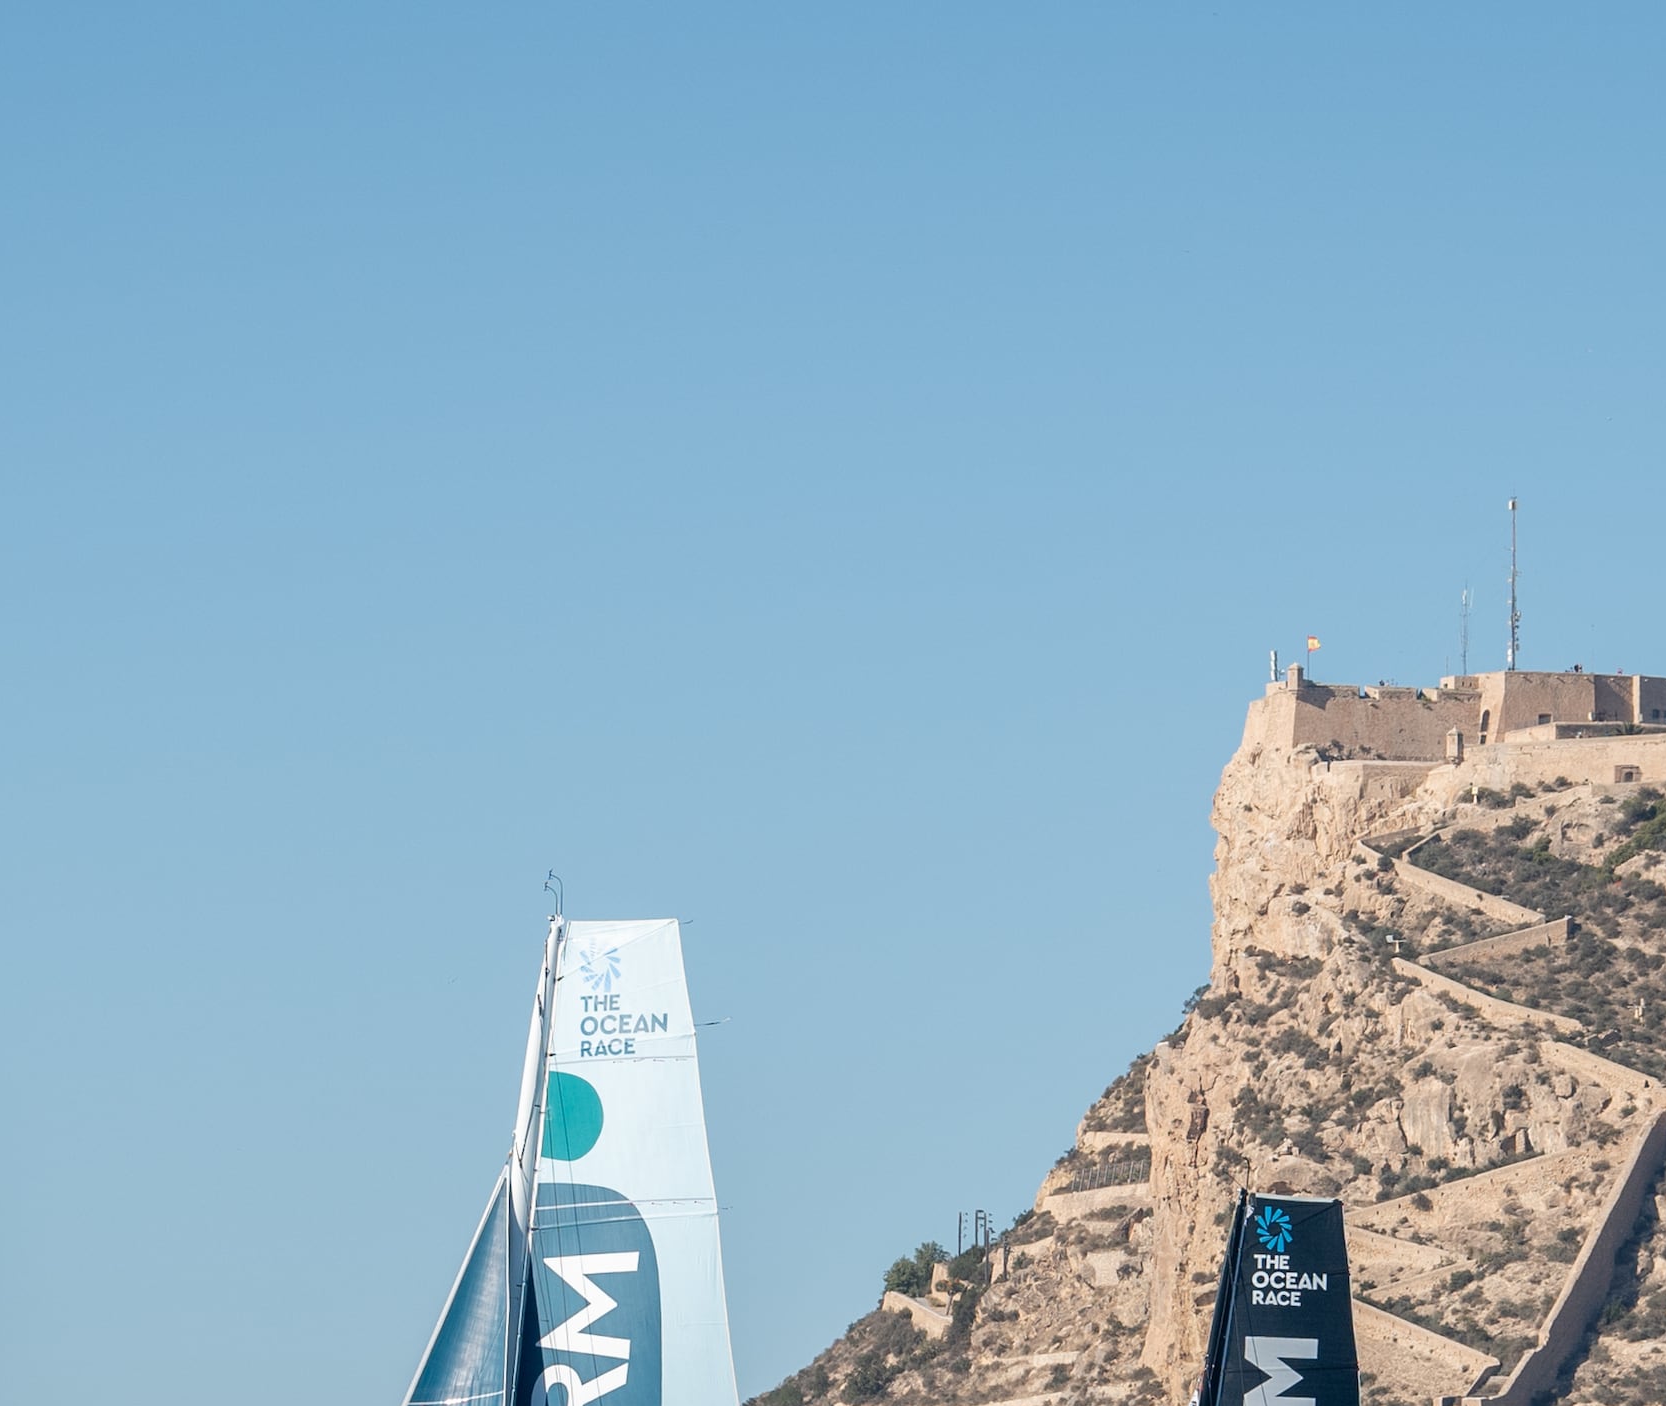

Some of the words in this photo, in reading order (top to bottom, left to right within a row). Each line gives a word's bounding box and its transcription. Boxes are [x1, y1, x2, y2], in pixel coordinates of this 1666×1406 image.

[580, 994, 620, 1012] THE
[580, 1013, 668, 1036] OCEAN
[580, 1037, 636, 1058] RACE
[1253, 1253, 1290, 1270] THE
[1251, 1271, 1328, 1291] OCEAN
[1251, 1290, 1302, 1307] RACE
